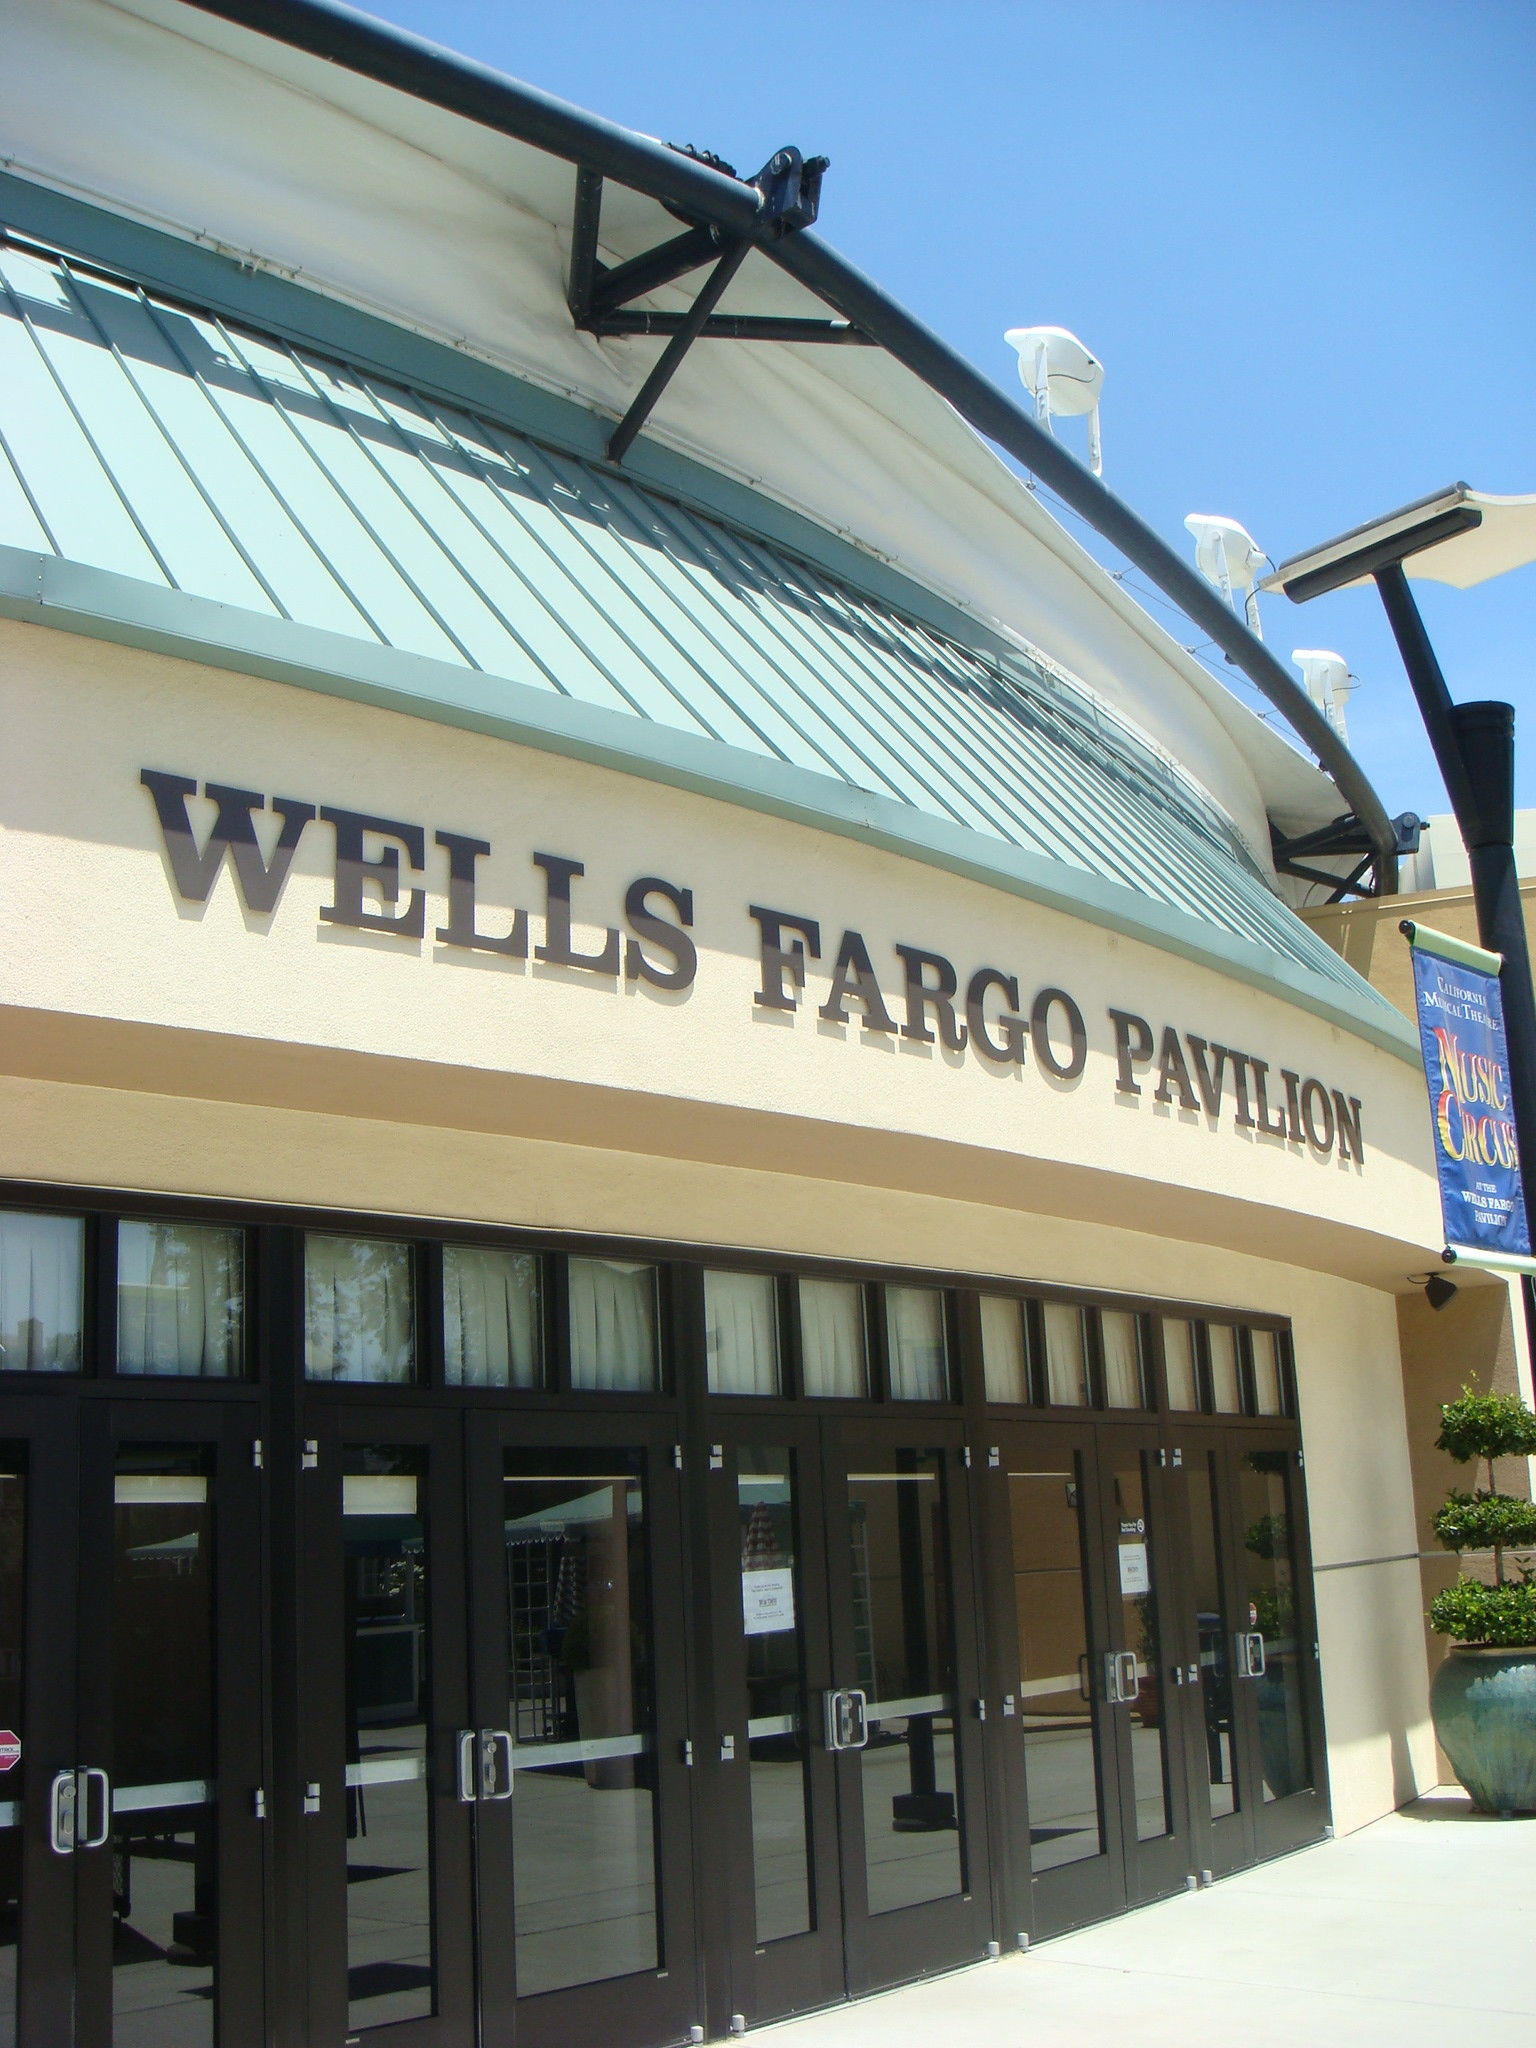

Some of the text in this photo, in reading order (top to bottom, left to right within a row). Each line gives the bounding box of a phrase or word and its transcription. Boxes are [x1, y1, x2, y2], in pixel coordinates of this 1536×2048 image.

[141, 769, 1364, 1165] WELLS FARGO PAVILION
[1437, 1090, 1520, 1172] CIRCUS
[1461, 1190, 1488, 1208] WELLS
[1482, 1182, 1497, 1193] THE
